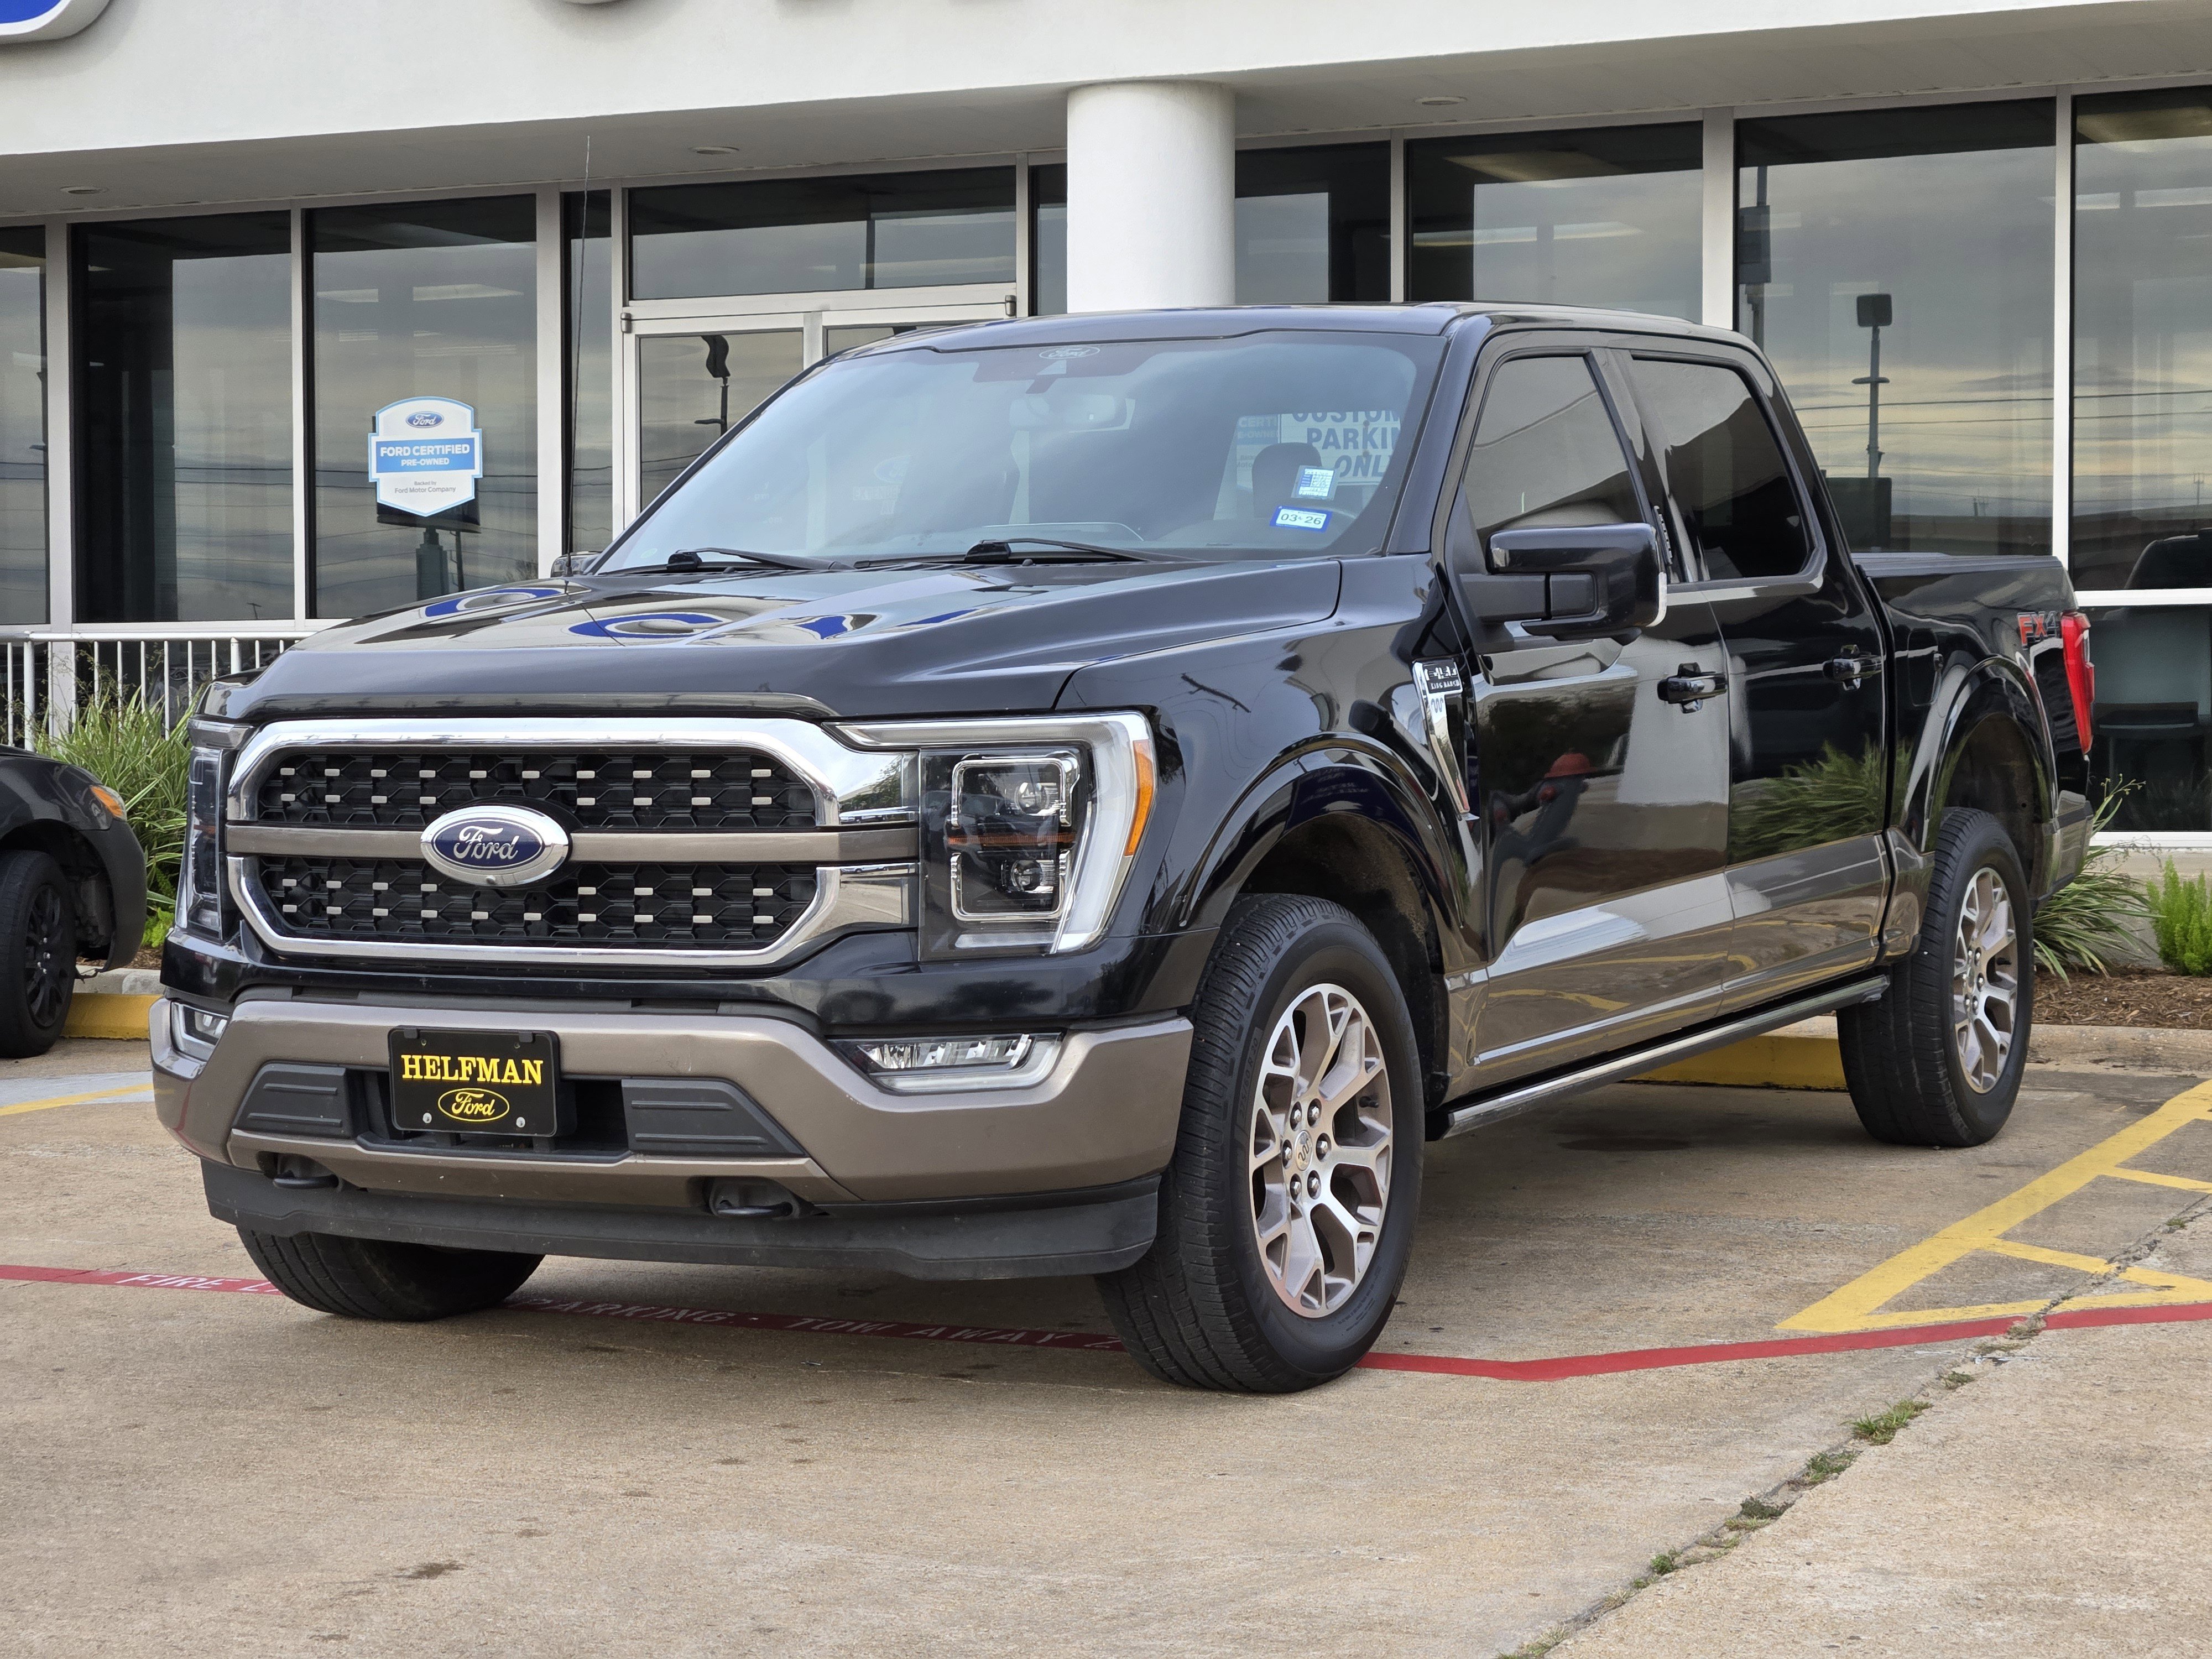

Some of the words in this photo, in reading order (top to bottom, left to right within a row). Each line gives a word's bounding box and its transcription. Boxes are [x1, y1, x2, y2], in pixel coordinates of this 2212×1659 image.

[413, 414, 436, 426] Ford
[1306, 427, 1401, 450] PARKI
[380, 446, 411, 457] FORD
[413, 444, 470, 456] CERTIFIED
[401, 457, 450, 466] PRE-OWNED
[1334, 455, 1391, 477] ONL
[2017, 611, 2059, 650] FX4
[453, 825, 520, 860] Ford
[401, 1055, 544, 1084] HELFMAN
[451, 1092, 495, 1116] Ford
[114, 1274, 242, 1289] FIRE
[507, 1298, 736, 1322] PARKING
[785, 1318, 898, 1333] TOW
[903, 1326, 1075, 1344] AWAY
